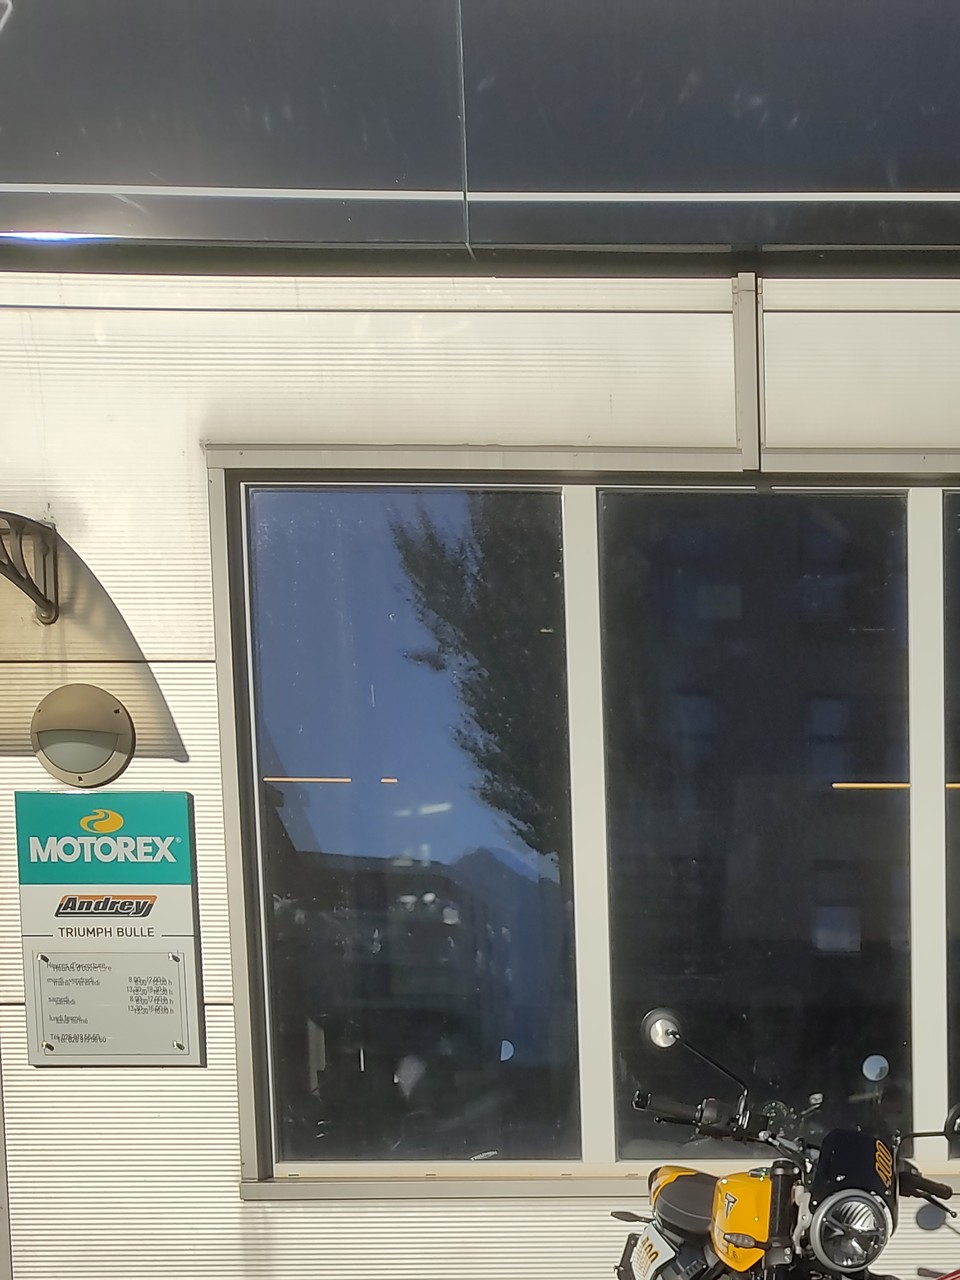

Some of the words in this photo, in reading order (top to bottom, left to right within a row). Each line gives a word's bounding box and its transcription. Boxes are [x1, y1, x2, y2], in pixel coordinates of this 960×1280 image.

[29, 836, 177, 863] MOTOREX
[61, 897, 149, 916] Andrey
[58, 927, 113, 938] TRIUMPH
[116, 927, 155, 938] BULLE
